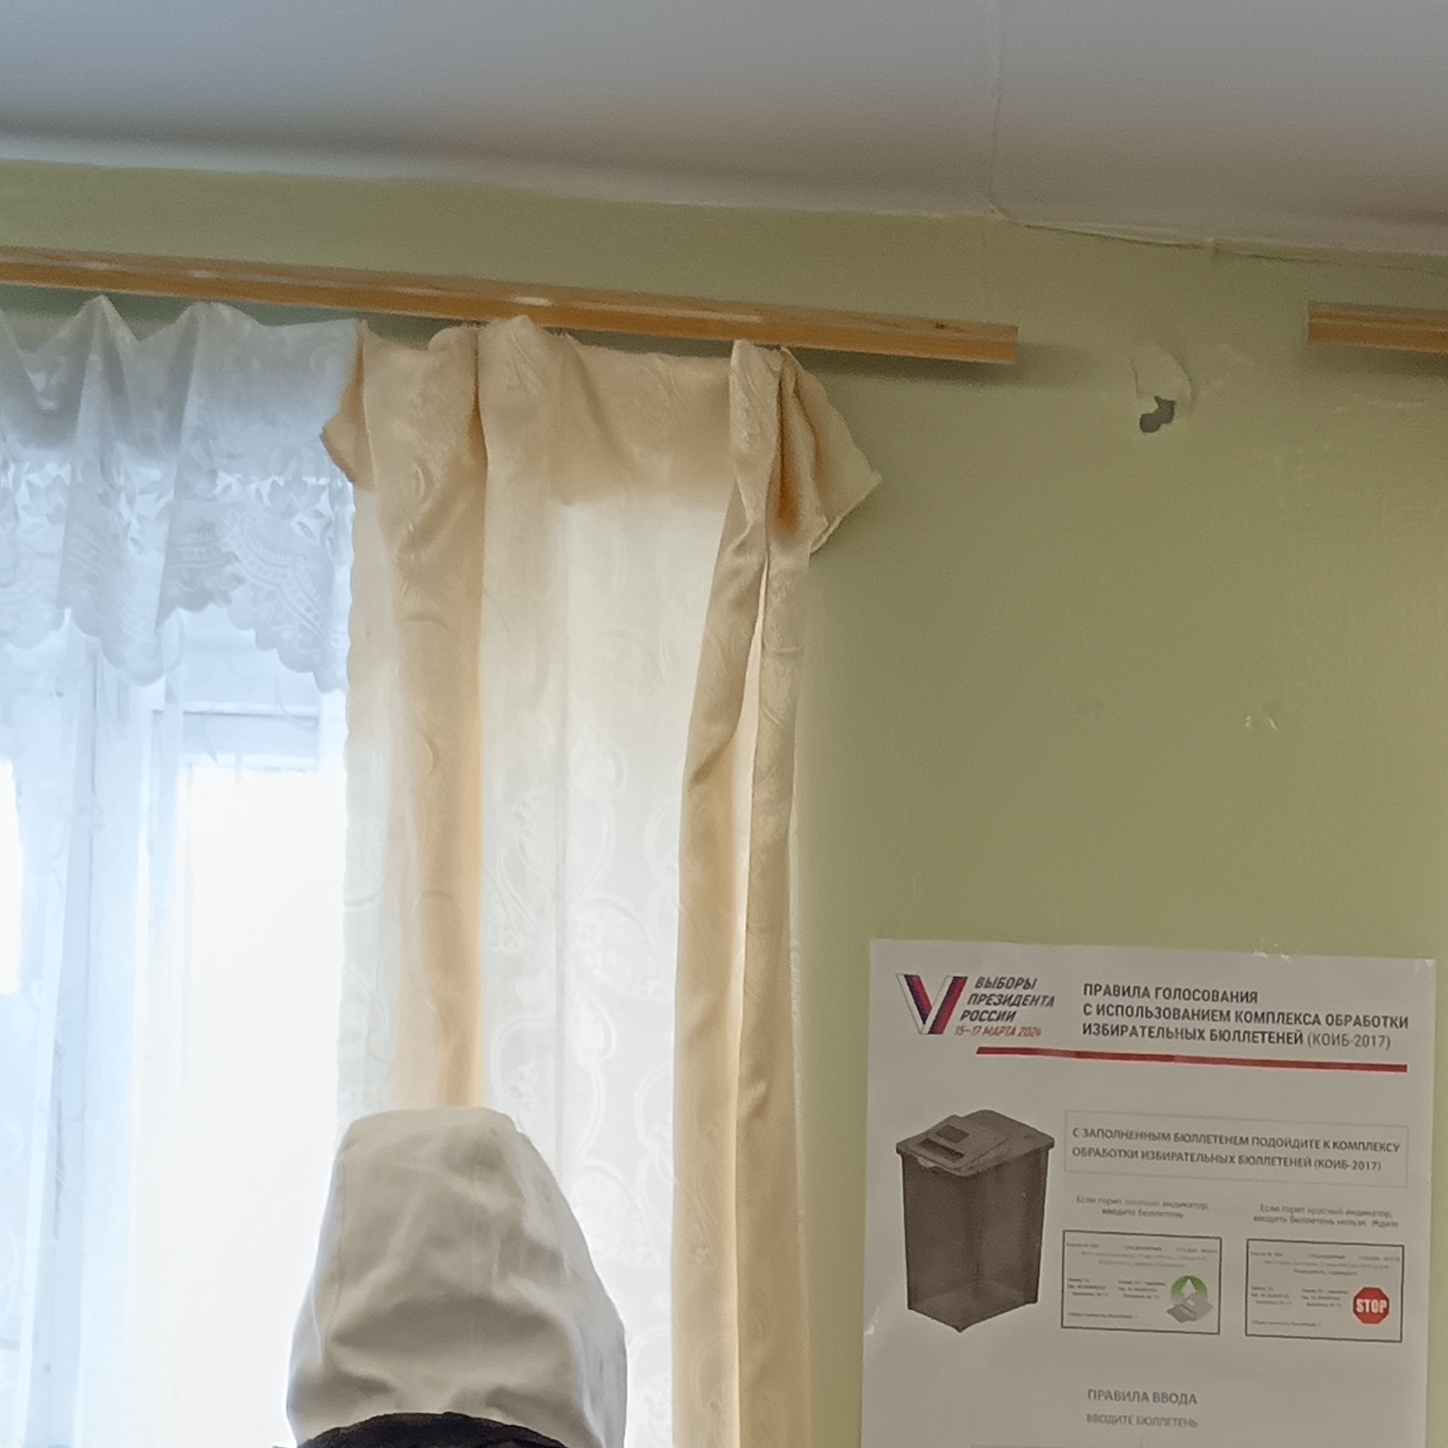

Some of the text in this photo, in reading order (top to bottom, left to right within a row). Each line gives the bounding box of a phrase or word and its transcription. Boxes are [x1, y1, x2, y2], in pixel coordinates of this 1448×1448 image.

[975, 976, 1038, 991] ВЫБОРЫ
[967, 993, 1056, 1008] ПРЕЗИДЕНТА
[1083, 983, 1258, 1004] ПРАВИЛА ГОЛОСОВАНИЯ
[960, 1009, 1017, 1023] РОССИИ
[1083, 1003, 1409, 1029] С ИСПОЛЬЗОВАНИЕМ КОМПЛЕКСА ОБРАБОТКИ
[983, 1026, 1017, 1037] МАРТА
[1017, 1026, 1042, 1037] 2024
[1082, 1023, 1391, 1050] ИЗБИРАТЕЛЬНЫХ БЮЛЛЕТЕНЕЙ (КОИБ-2017)
[1072, 1127, 1400, 1154] С ЗАПОЛНЕННЫМ БЮЛЛЕТЕНЕМ ПОДОЙДИТЕ К КОМПЛЕКСУ
[1071, 1146, 1382, 1172] ОБРАБОТКИ ИЗБИРАТЕЛЬНЫХ БЮЛЛЕТЕНЕЙ (КОИБ-2017)
[1355, 1298, 1388, 1313] STOP
[1087, 1388, 1198, 1406] ПРАВИЛА ВВОДА
[1086, 1413, 1199, 1428] ВВОДИТЕ БЮЛЛЕТЕНЬ
